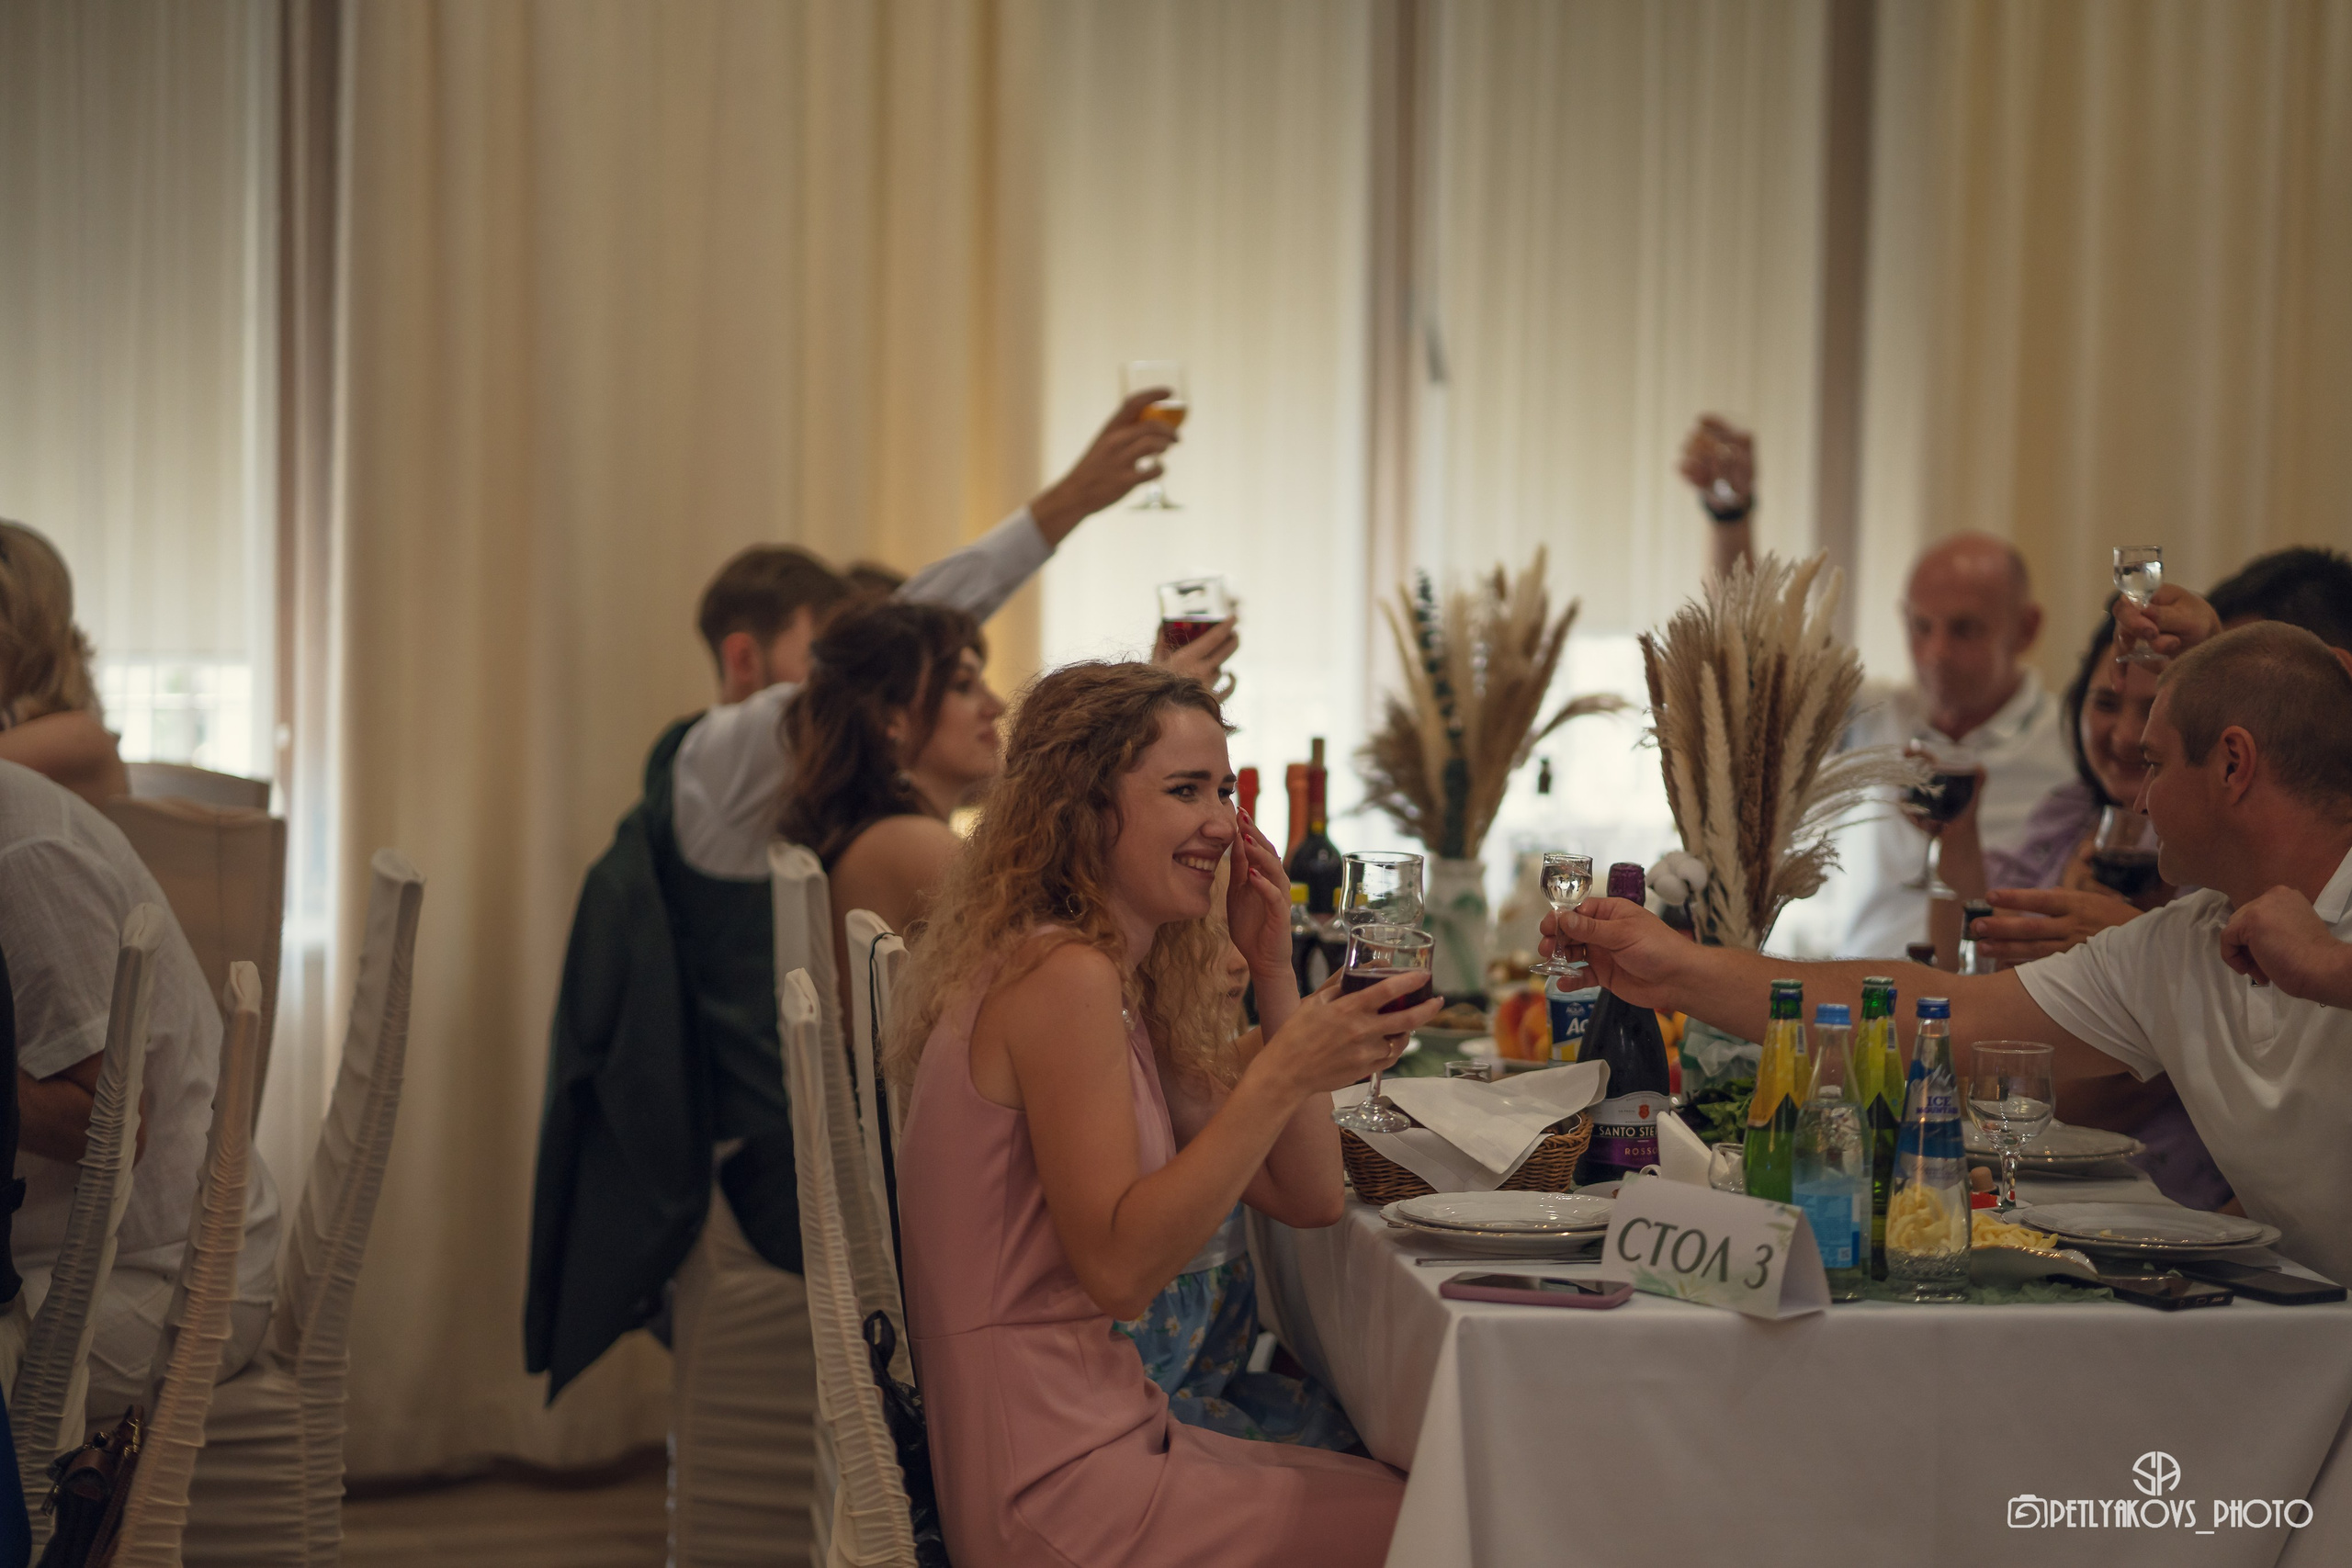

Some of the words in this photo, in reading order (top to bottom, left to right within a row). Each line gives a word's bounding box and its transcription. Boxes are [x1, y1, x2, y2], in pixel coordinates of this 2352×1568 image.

[1927, 1095, 1951, 1107] ICE
[1599, 1125, 1635, 1137] SANTO
[1639, 1125, 1657, 1137] STE
[1624, 1146, 1657, 1156] ROSSO
[1617, 1216, 1731, 1282] СТОЛ
[1743, 1243, 1774, 1290] 3
